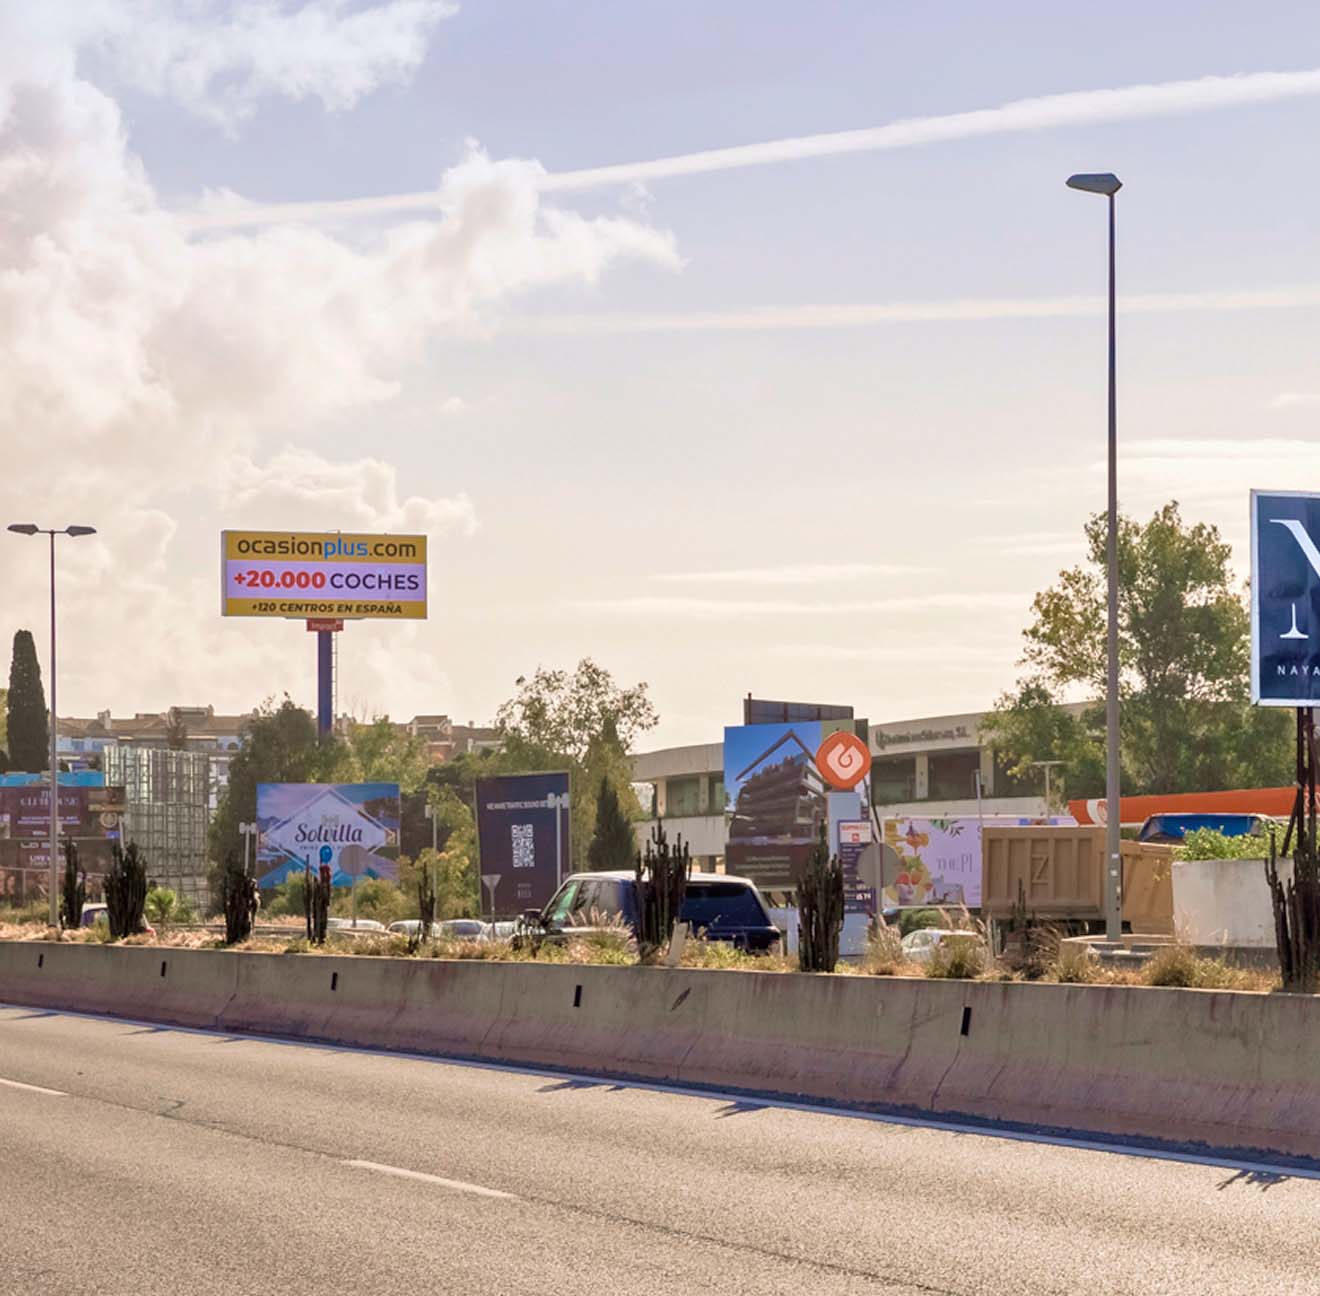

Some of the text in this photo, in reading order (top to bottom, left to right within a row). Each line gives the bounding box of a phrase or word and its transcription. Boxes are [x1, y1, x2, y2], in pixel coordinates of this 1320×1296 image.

[237, 536, 416, 559] ocasionplus.com
[234, 570, 420, 590] +20.000 COCHES
[252, 601, 402, 614] +120 CENTROS EN ESPAÑA
[294, 822, 363, 842] Solvilla
